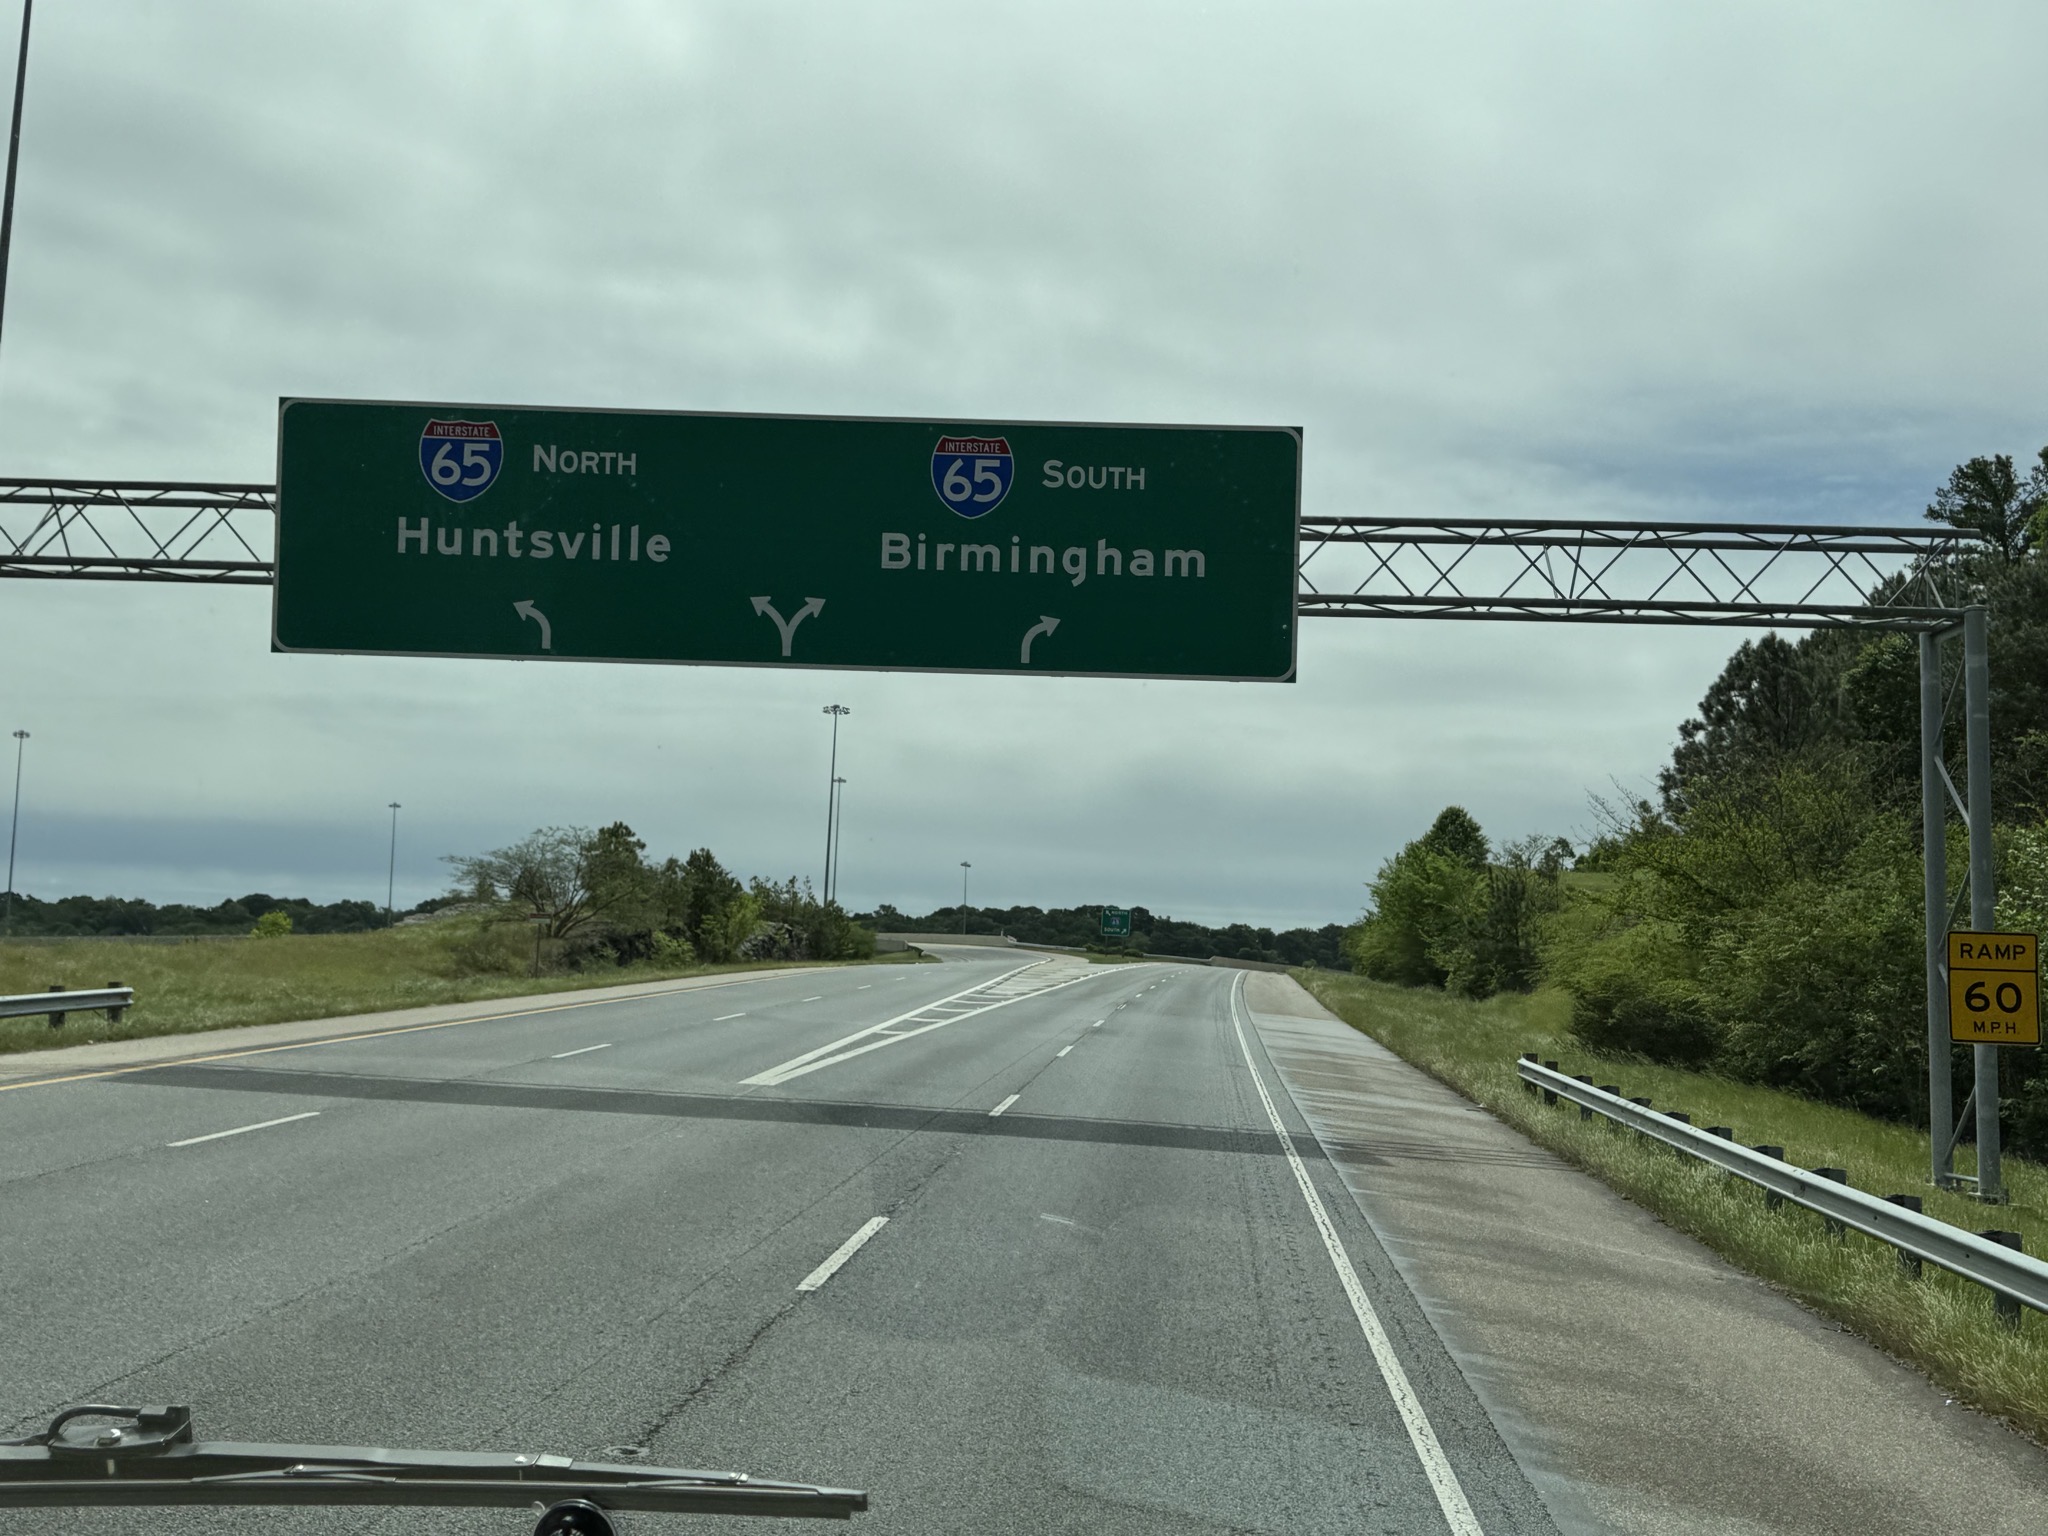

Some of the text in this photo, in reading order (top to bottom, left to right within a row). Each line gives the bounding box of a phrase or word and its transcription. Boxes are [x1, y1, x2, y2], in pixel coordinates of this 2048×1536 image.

[434, 425, 490, 437] INTERSTATE
[945, 441, 1000, 453] INTERSTATE
[431, 442, 491, 486] 65
[943, 458, 1002, 503] 65
[398, 516, 670, 562] Huntsville
[881, 532, 1205, 587] Birmingham
[1960, 943, 2026, 960] RAMP
[1965, 982, 2022, 1013] 60
